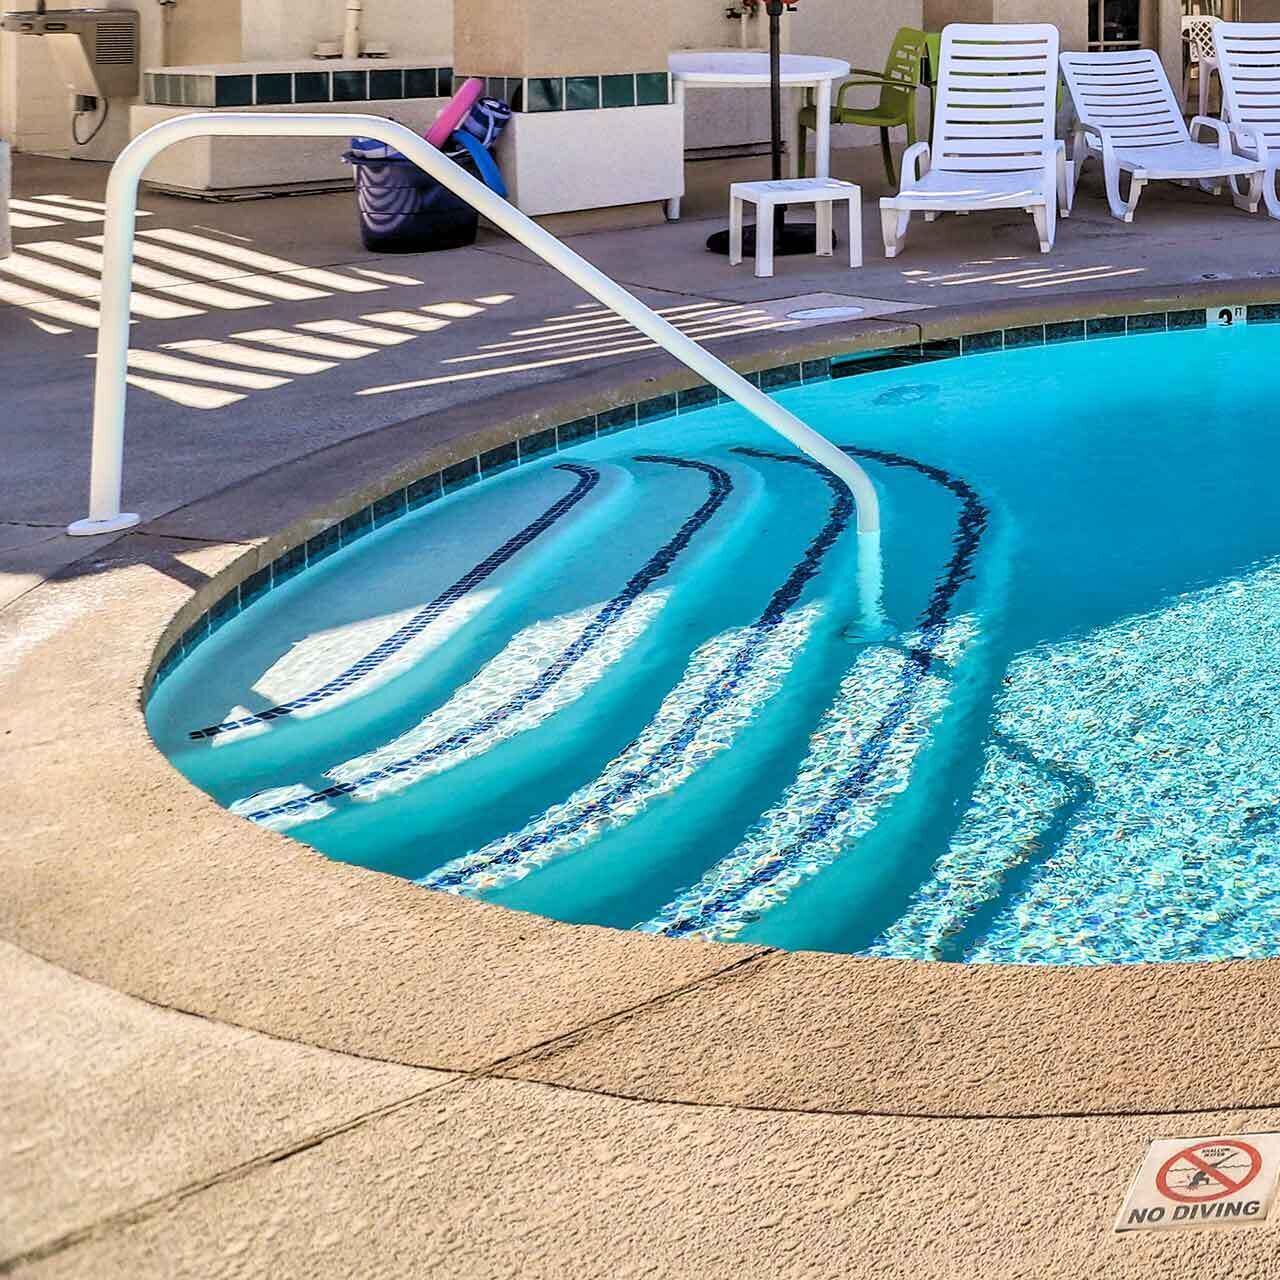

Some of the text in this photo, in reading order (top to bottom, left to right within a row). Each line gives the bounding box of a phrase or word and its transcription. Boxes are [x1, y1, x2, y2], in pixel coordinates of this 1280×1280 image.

[1235, 307, 1242, 317] FT
[1128, 1200, 1260, 1224] NO DIVING
